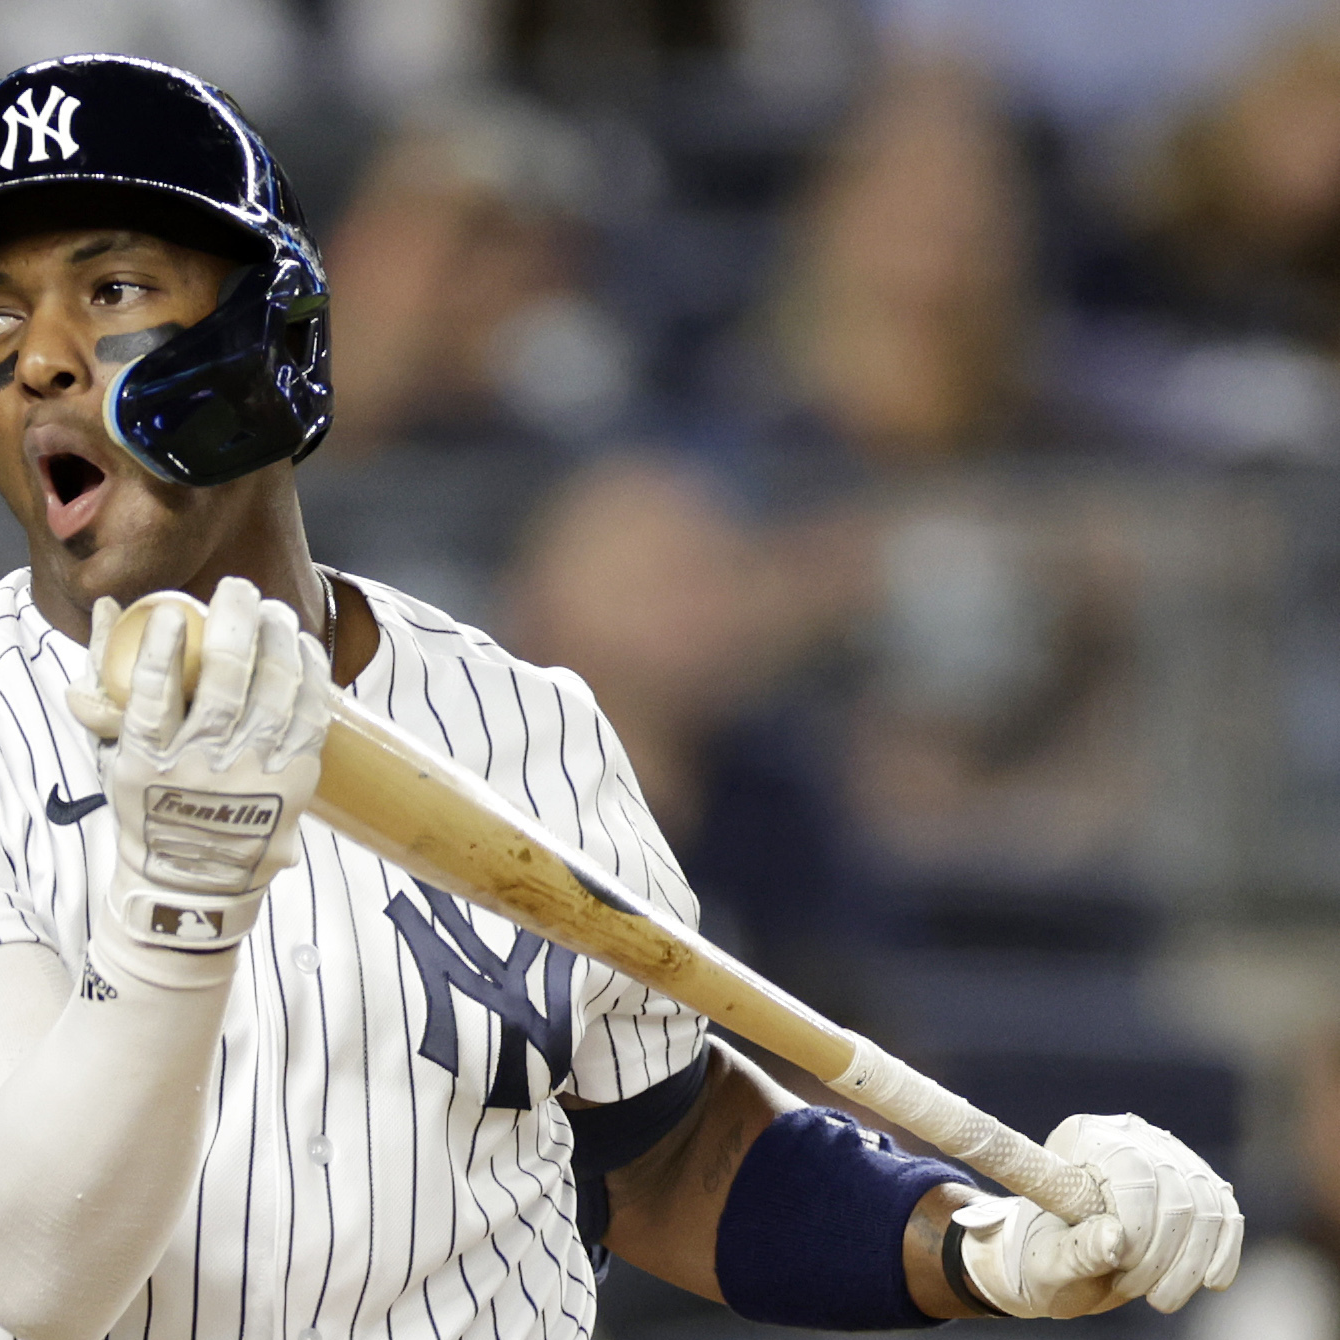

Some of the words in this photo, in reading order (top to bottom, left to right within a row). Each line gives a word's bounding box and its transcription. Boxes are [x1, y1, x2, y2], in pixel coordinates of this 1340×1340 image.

[0, 85, 81, 170] NY
[152, 792, 273, 825] Franklin
[383, 875, 579, 1110] NY
